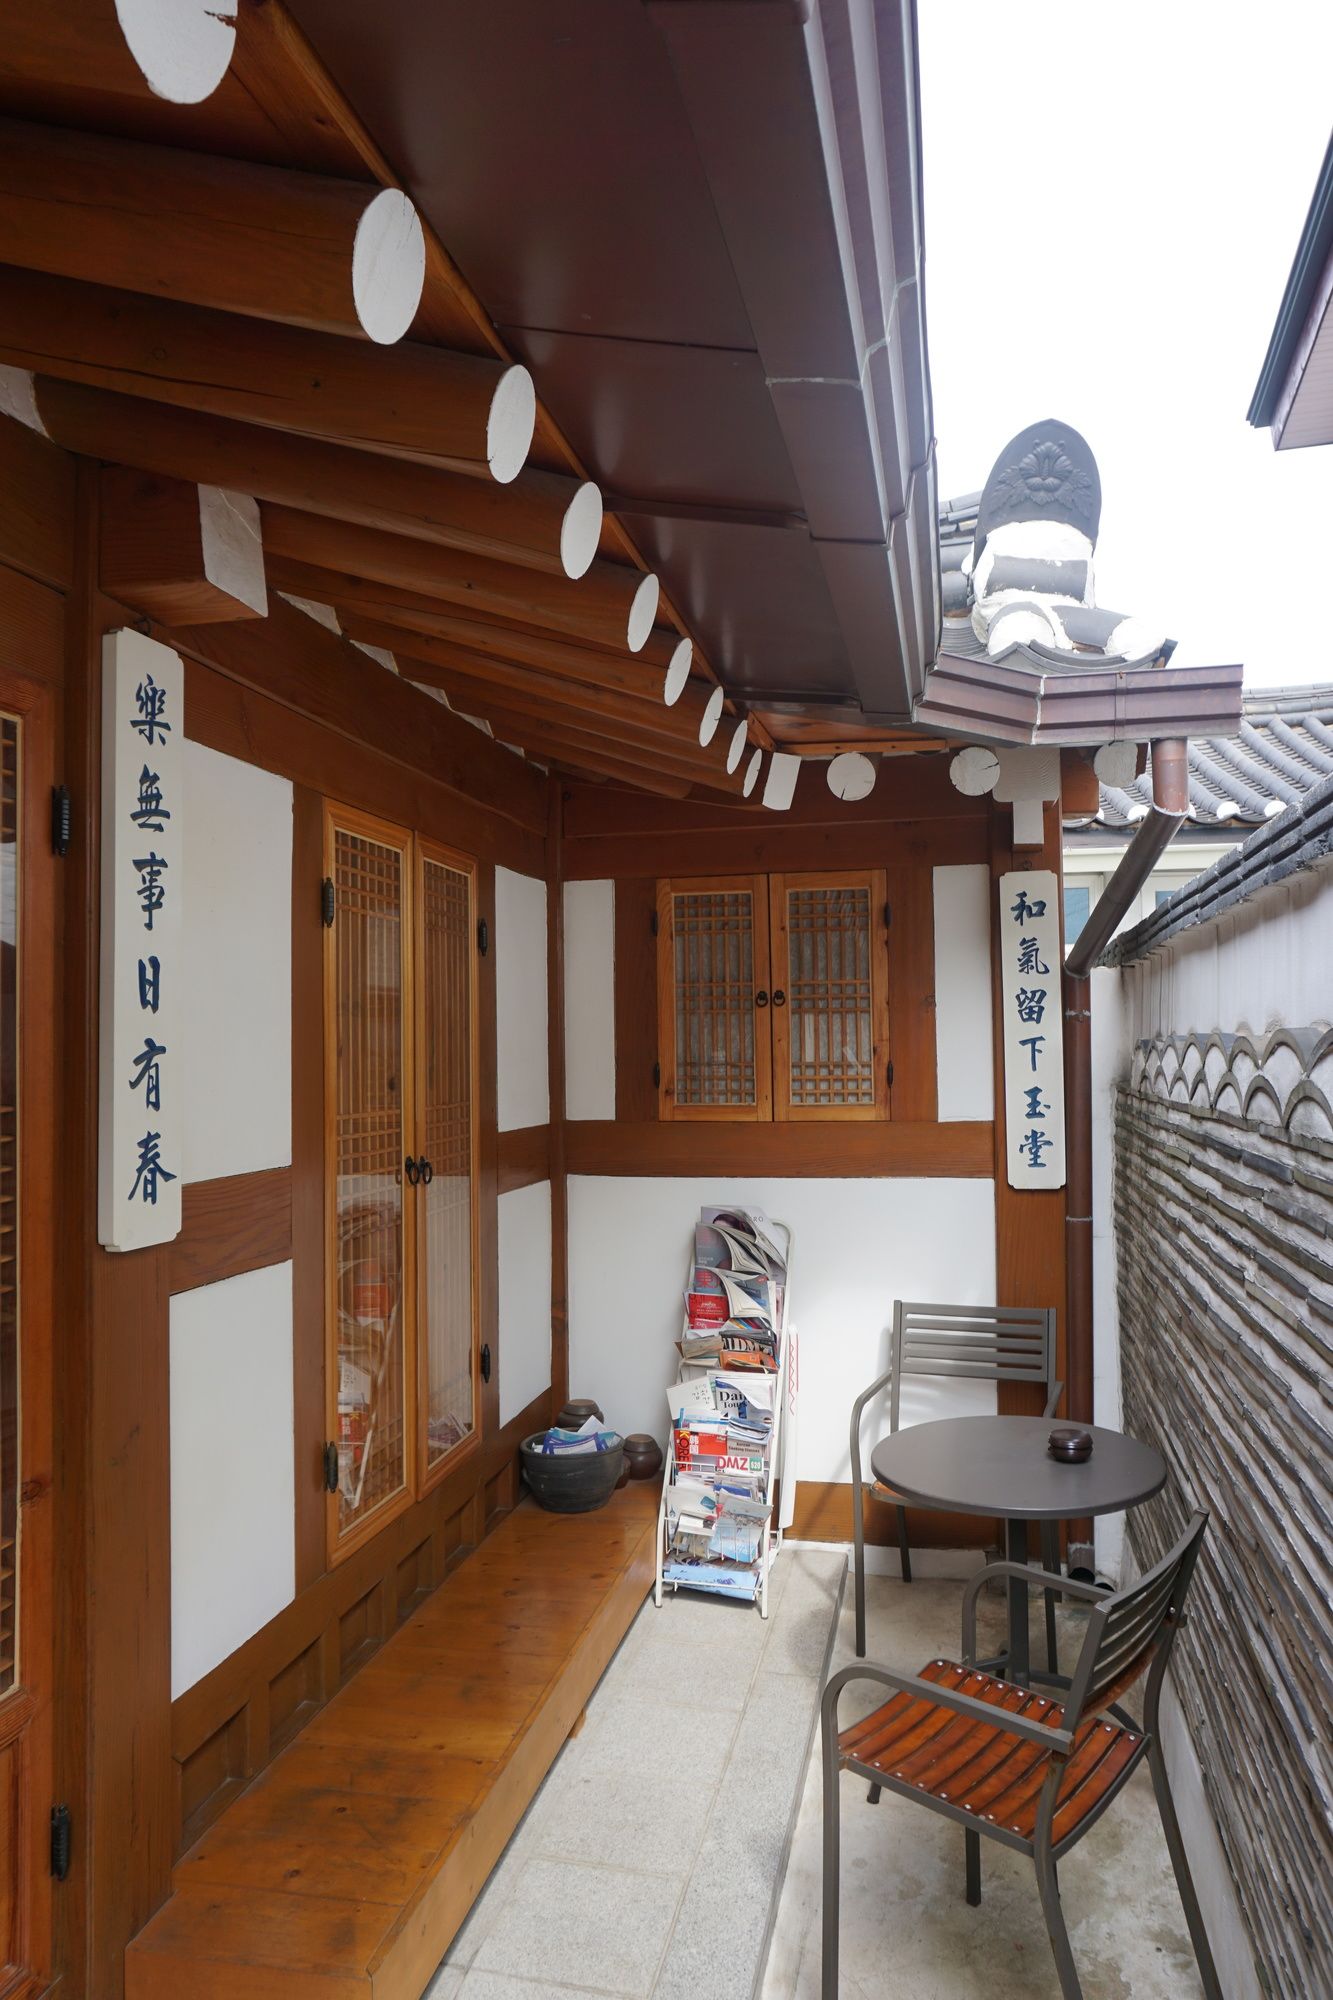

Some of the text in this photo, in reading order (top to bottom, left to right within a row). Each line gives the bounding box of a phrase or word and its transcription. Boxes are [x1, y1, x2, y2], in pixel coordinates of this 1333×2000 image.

[1011, 891, 1054, 1169] 和氣留下玉堂
[717, 1456, 748, 1471] DMZ
